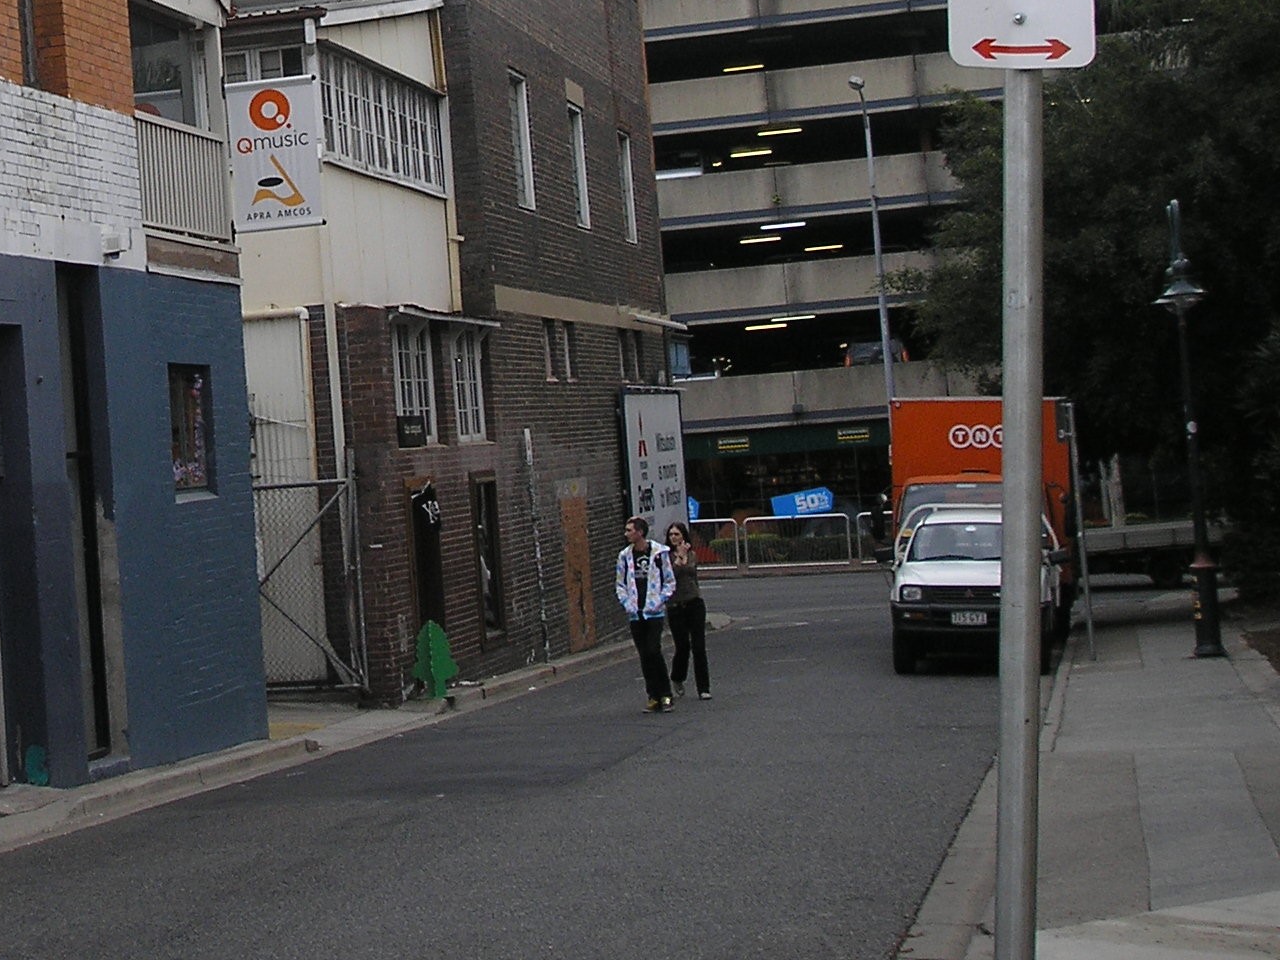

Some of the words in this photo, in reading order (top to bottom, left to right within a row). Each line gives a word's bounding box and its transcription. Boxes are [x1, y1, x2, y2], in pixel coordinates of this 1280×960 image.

[237, 129, 309, 154] Qmusic
[246, 211, 271, 221] APRA
[277, 206, 312, 218] AMCOS
